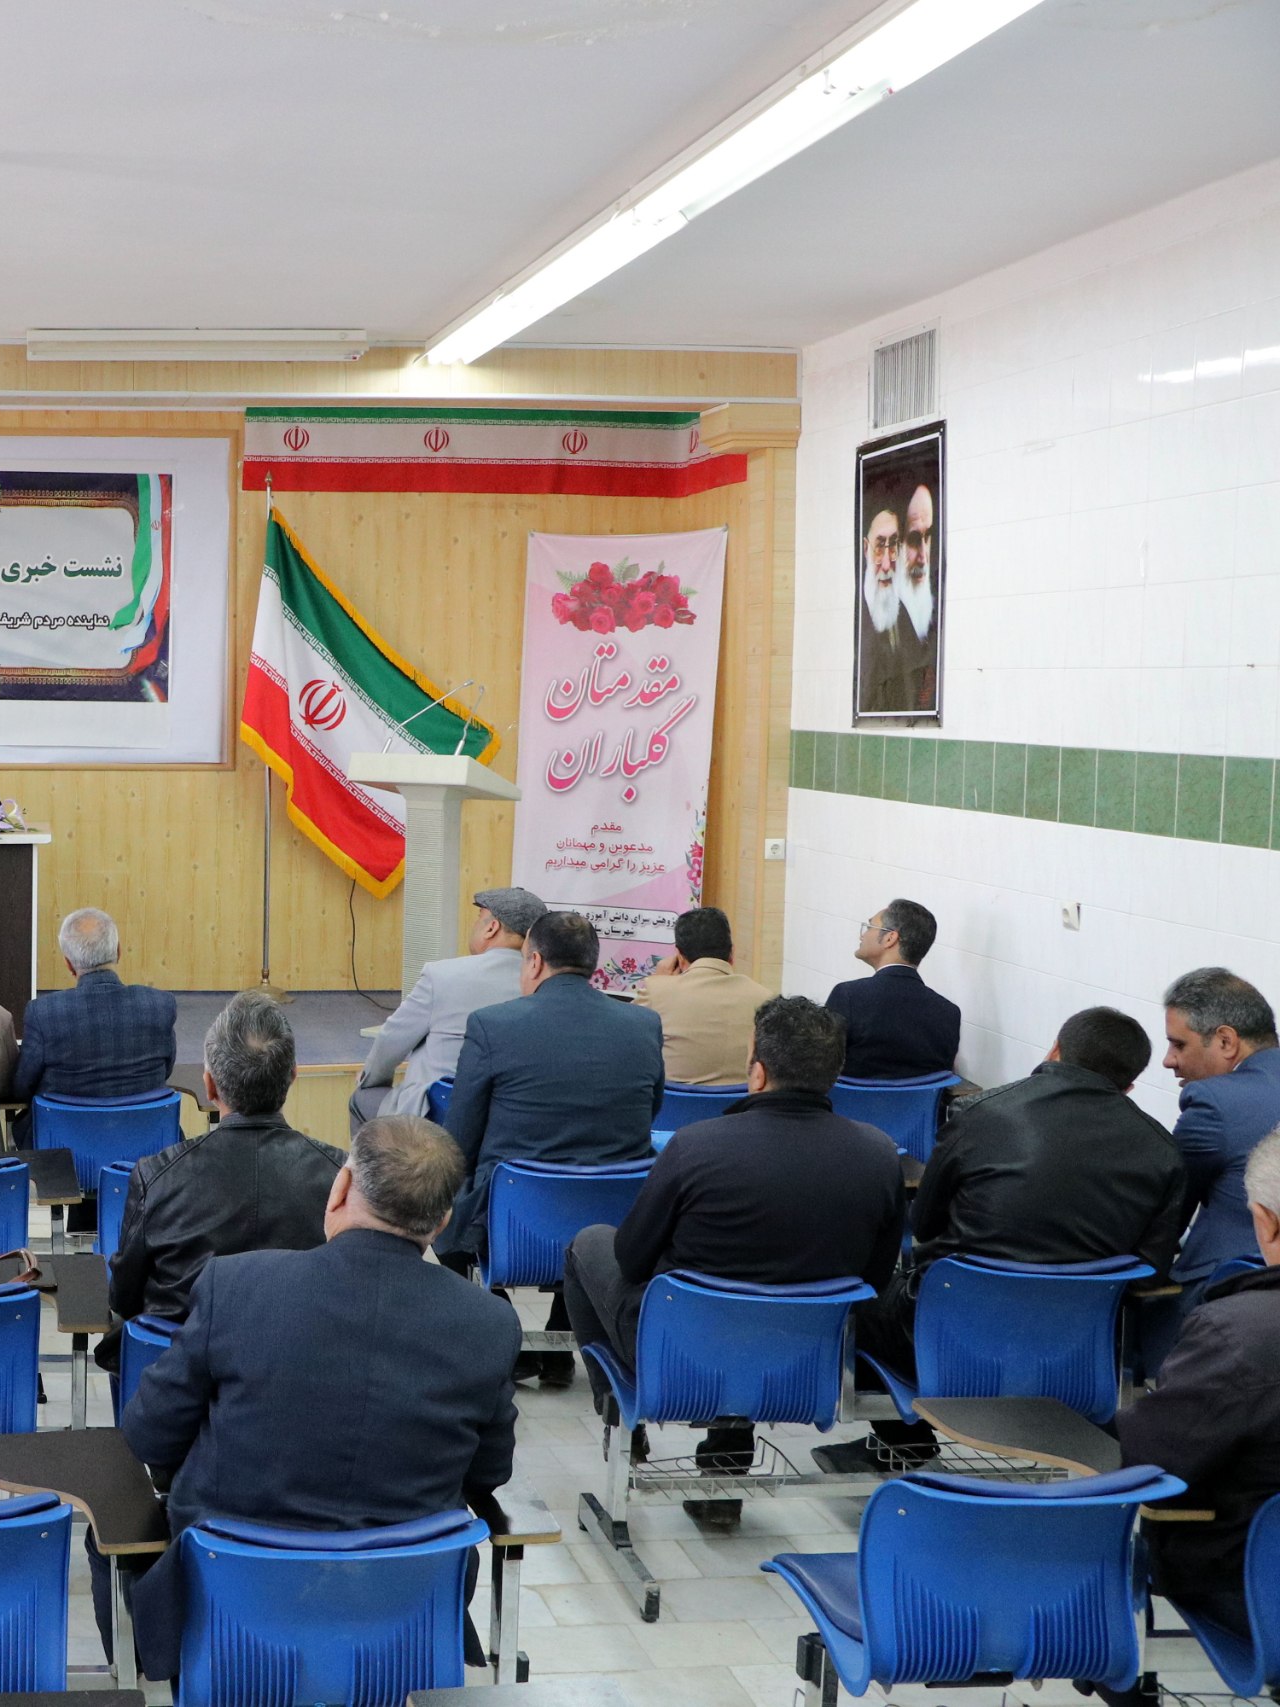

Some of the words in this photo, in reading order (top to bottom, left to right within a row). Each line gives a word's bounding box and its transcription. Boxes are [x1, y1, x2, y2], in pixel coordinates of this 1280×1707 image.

[1, 555, 57, 583] خبری
[63, 556, 123, 578] نشست
[33, 615, 65, 629] مردم
[67, 614, 110, 630] نماینده
[545, 642, 681, 721] مقدمتان
[546, 694, 696, 802] گلباران
[590, 821, 623, 835] مقدم
[556, 837, 596, 851] مهمانان
[599, 841, 605, 852] و
[608, 842, 653, 854] مدعوین
[590, 857, 624, 871] گرامی
[627, 859, 636, 872] را
[639, 861, 665, 873] عزیز
